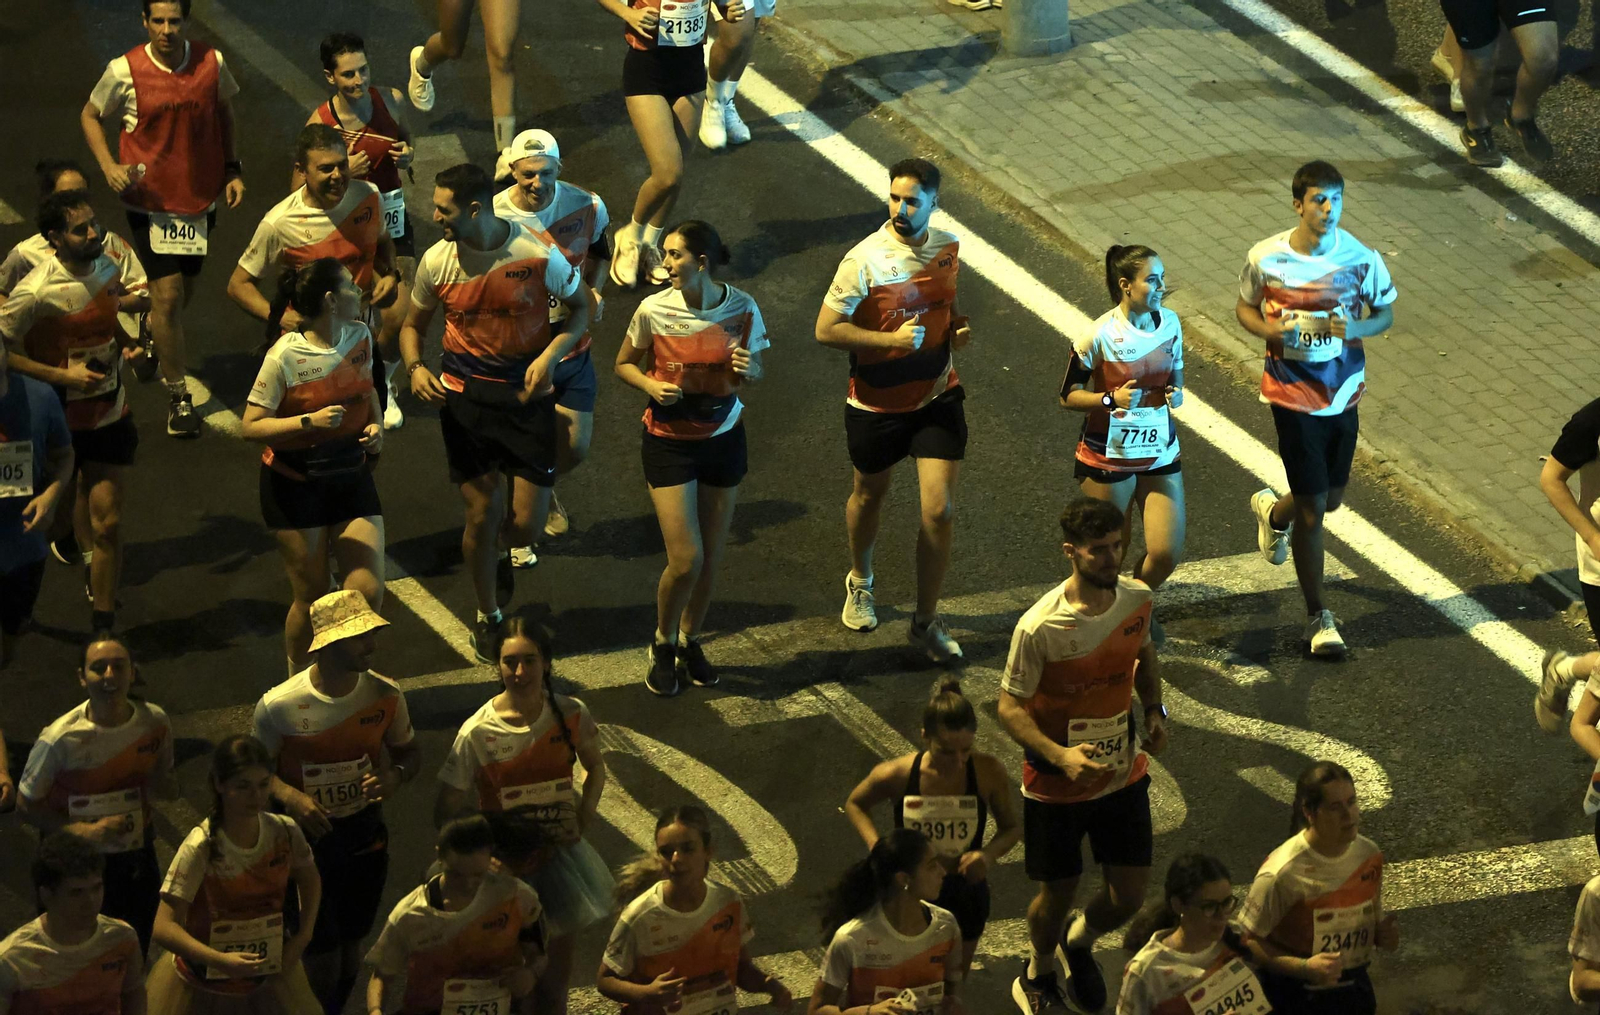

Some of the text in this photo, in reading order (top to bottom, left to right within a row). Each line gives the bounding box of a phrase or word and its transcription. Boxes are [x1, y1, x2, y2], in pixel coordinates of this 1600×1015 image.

[665, 16, 704, 34] 21383
[161, 224, 196, 240] 1840
[505, 268, 531, 282] KH7
[666, 361, 683, 372] 37
[1121, 429, 1158, 444] 7718
[0, 464, 23, 480] 05
[314, 783, 363, 804] 1150
[1321, 928, 1368, 952] 23479
